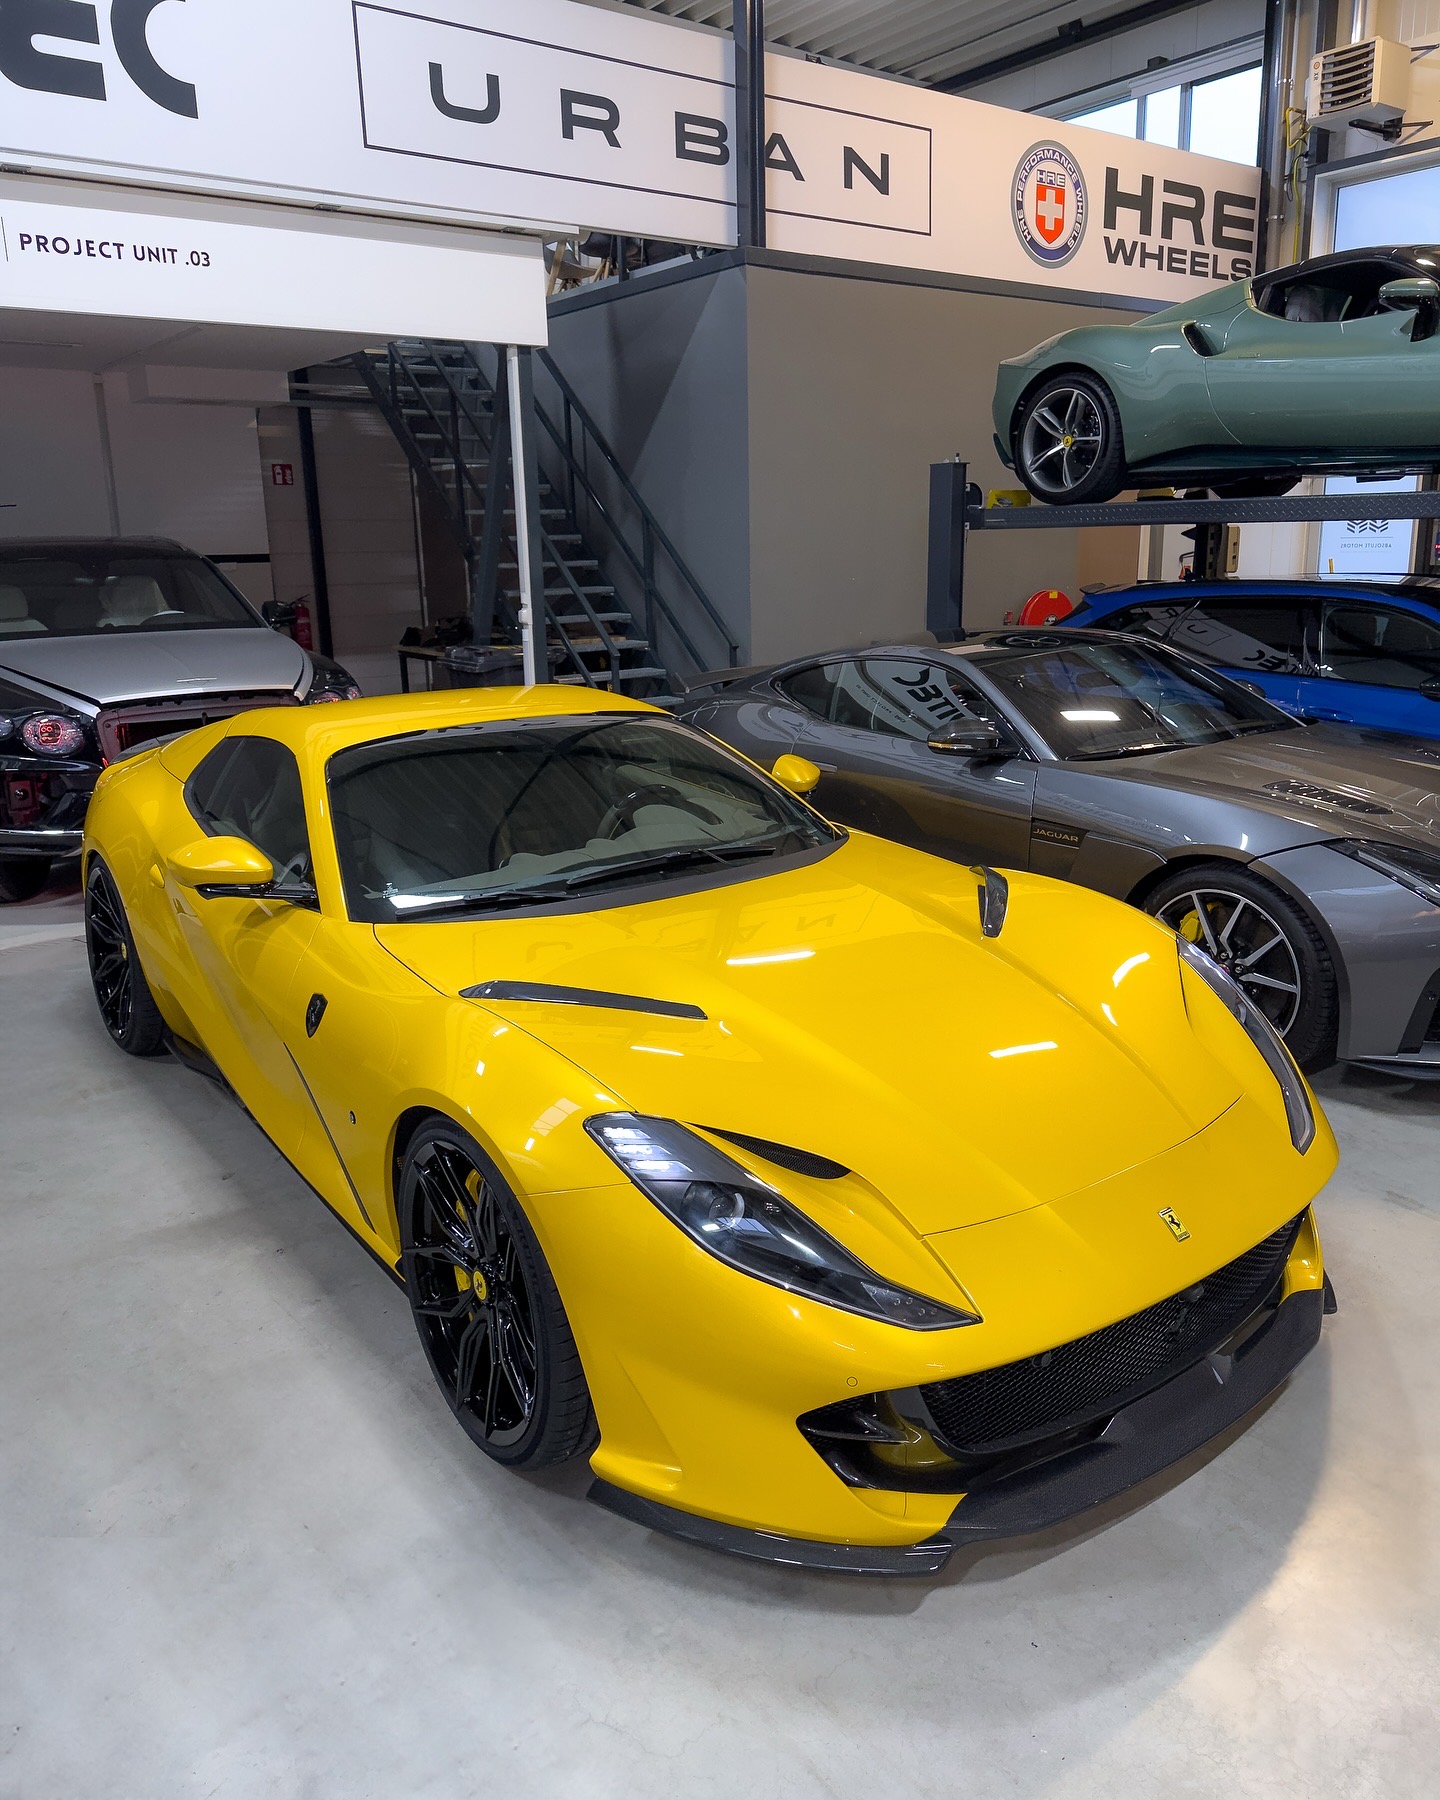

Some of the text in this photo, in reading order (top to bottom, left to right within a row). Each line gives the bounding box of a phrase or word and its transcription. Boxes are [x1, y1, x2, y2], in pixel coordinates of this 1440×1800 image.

[428, 61, 890, 196] URBAN
[1017, 149, 1084, 249] HRE PERFORMANCE WHEELS
[1036, 169, 1065, 188] HRE
[1103, 166, 1257, 254] HRE
[19, 233, 211, 267] PROJECT UNIT .03
[1103, 236, 1252, 282] WHEELS
[1033, 828, 1079, 842] JAGUAR
